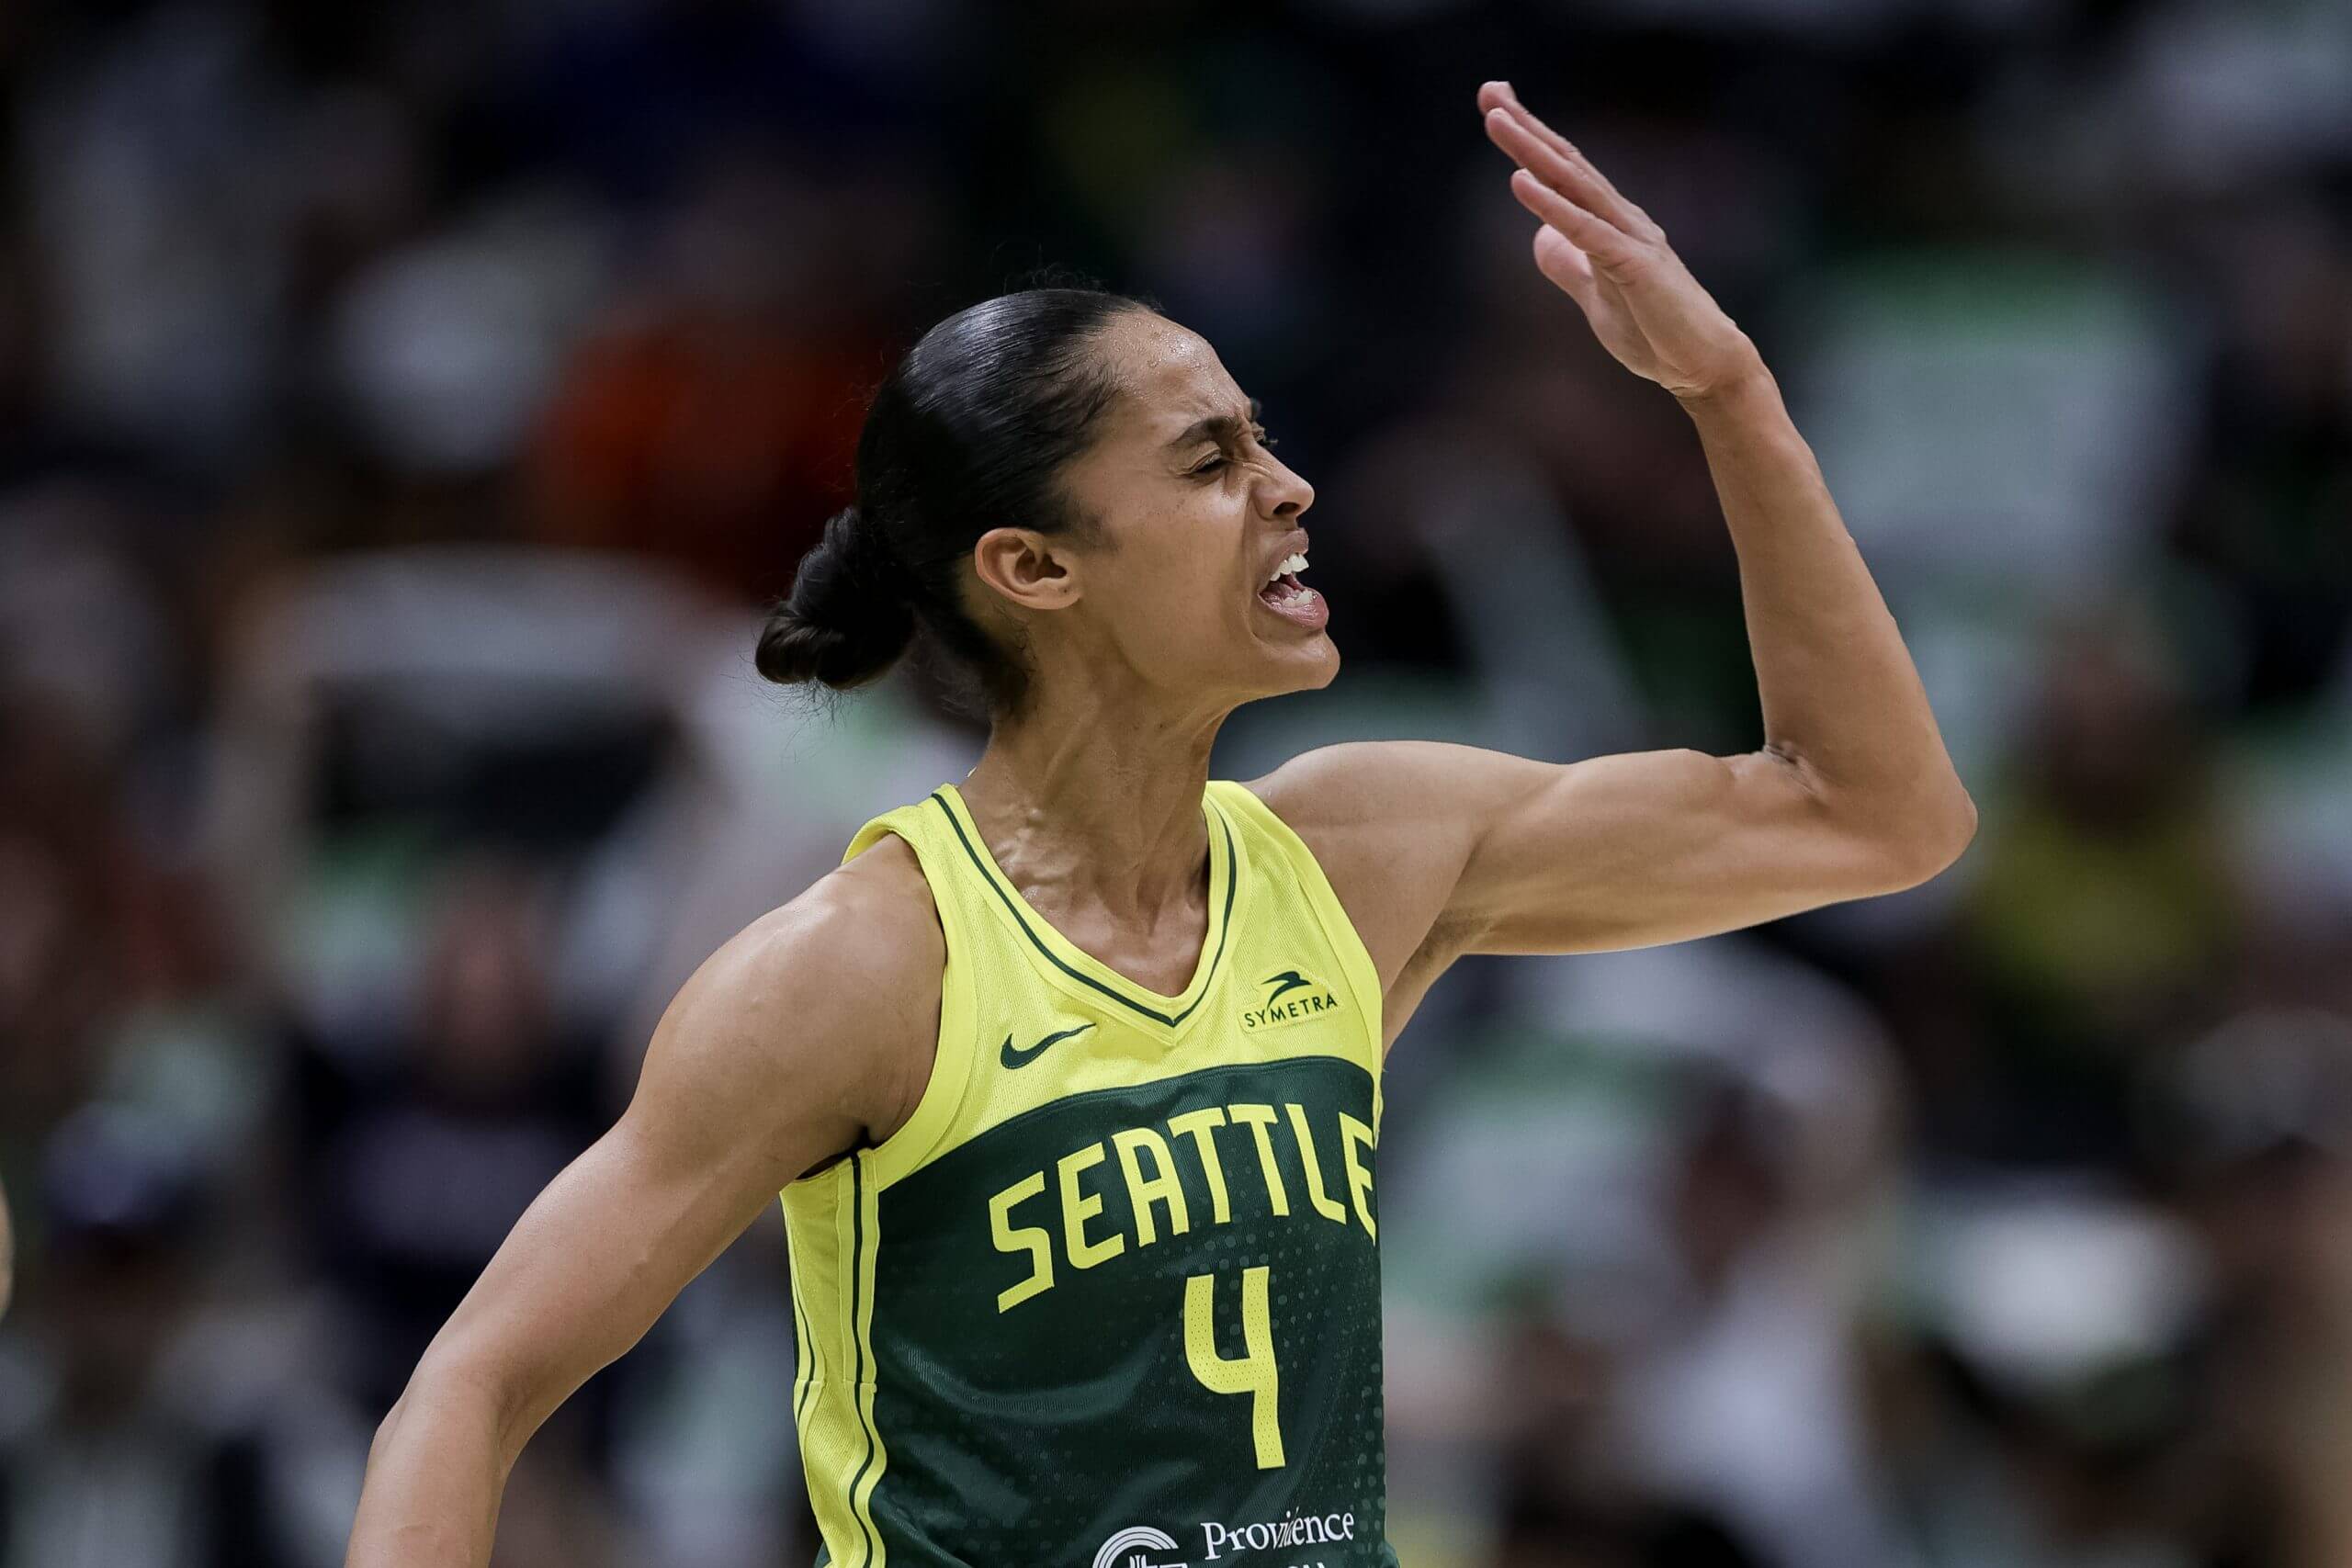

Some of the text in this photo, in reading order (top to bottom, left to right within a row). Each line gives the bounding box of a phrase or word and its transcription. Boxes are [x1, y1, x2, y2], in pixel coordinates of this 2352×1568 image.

[1244, 992, 1339, 1028] SYMETRA
[988, 1103, 1376, 1314] SEATTLE
[1183, 1266, 1286, 1470] 4
[1200, 1506, 1355, 1561] Provience
